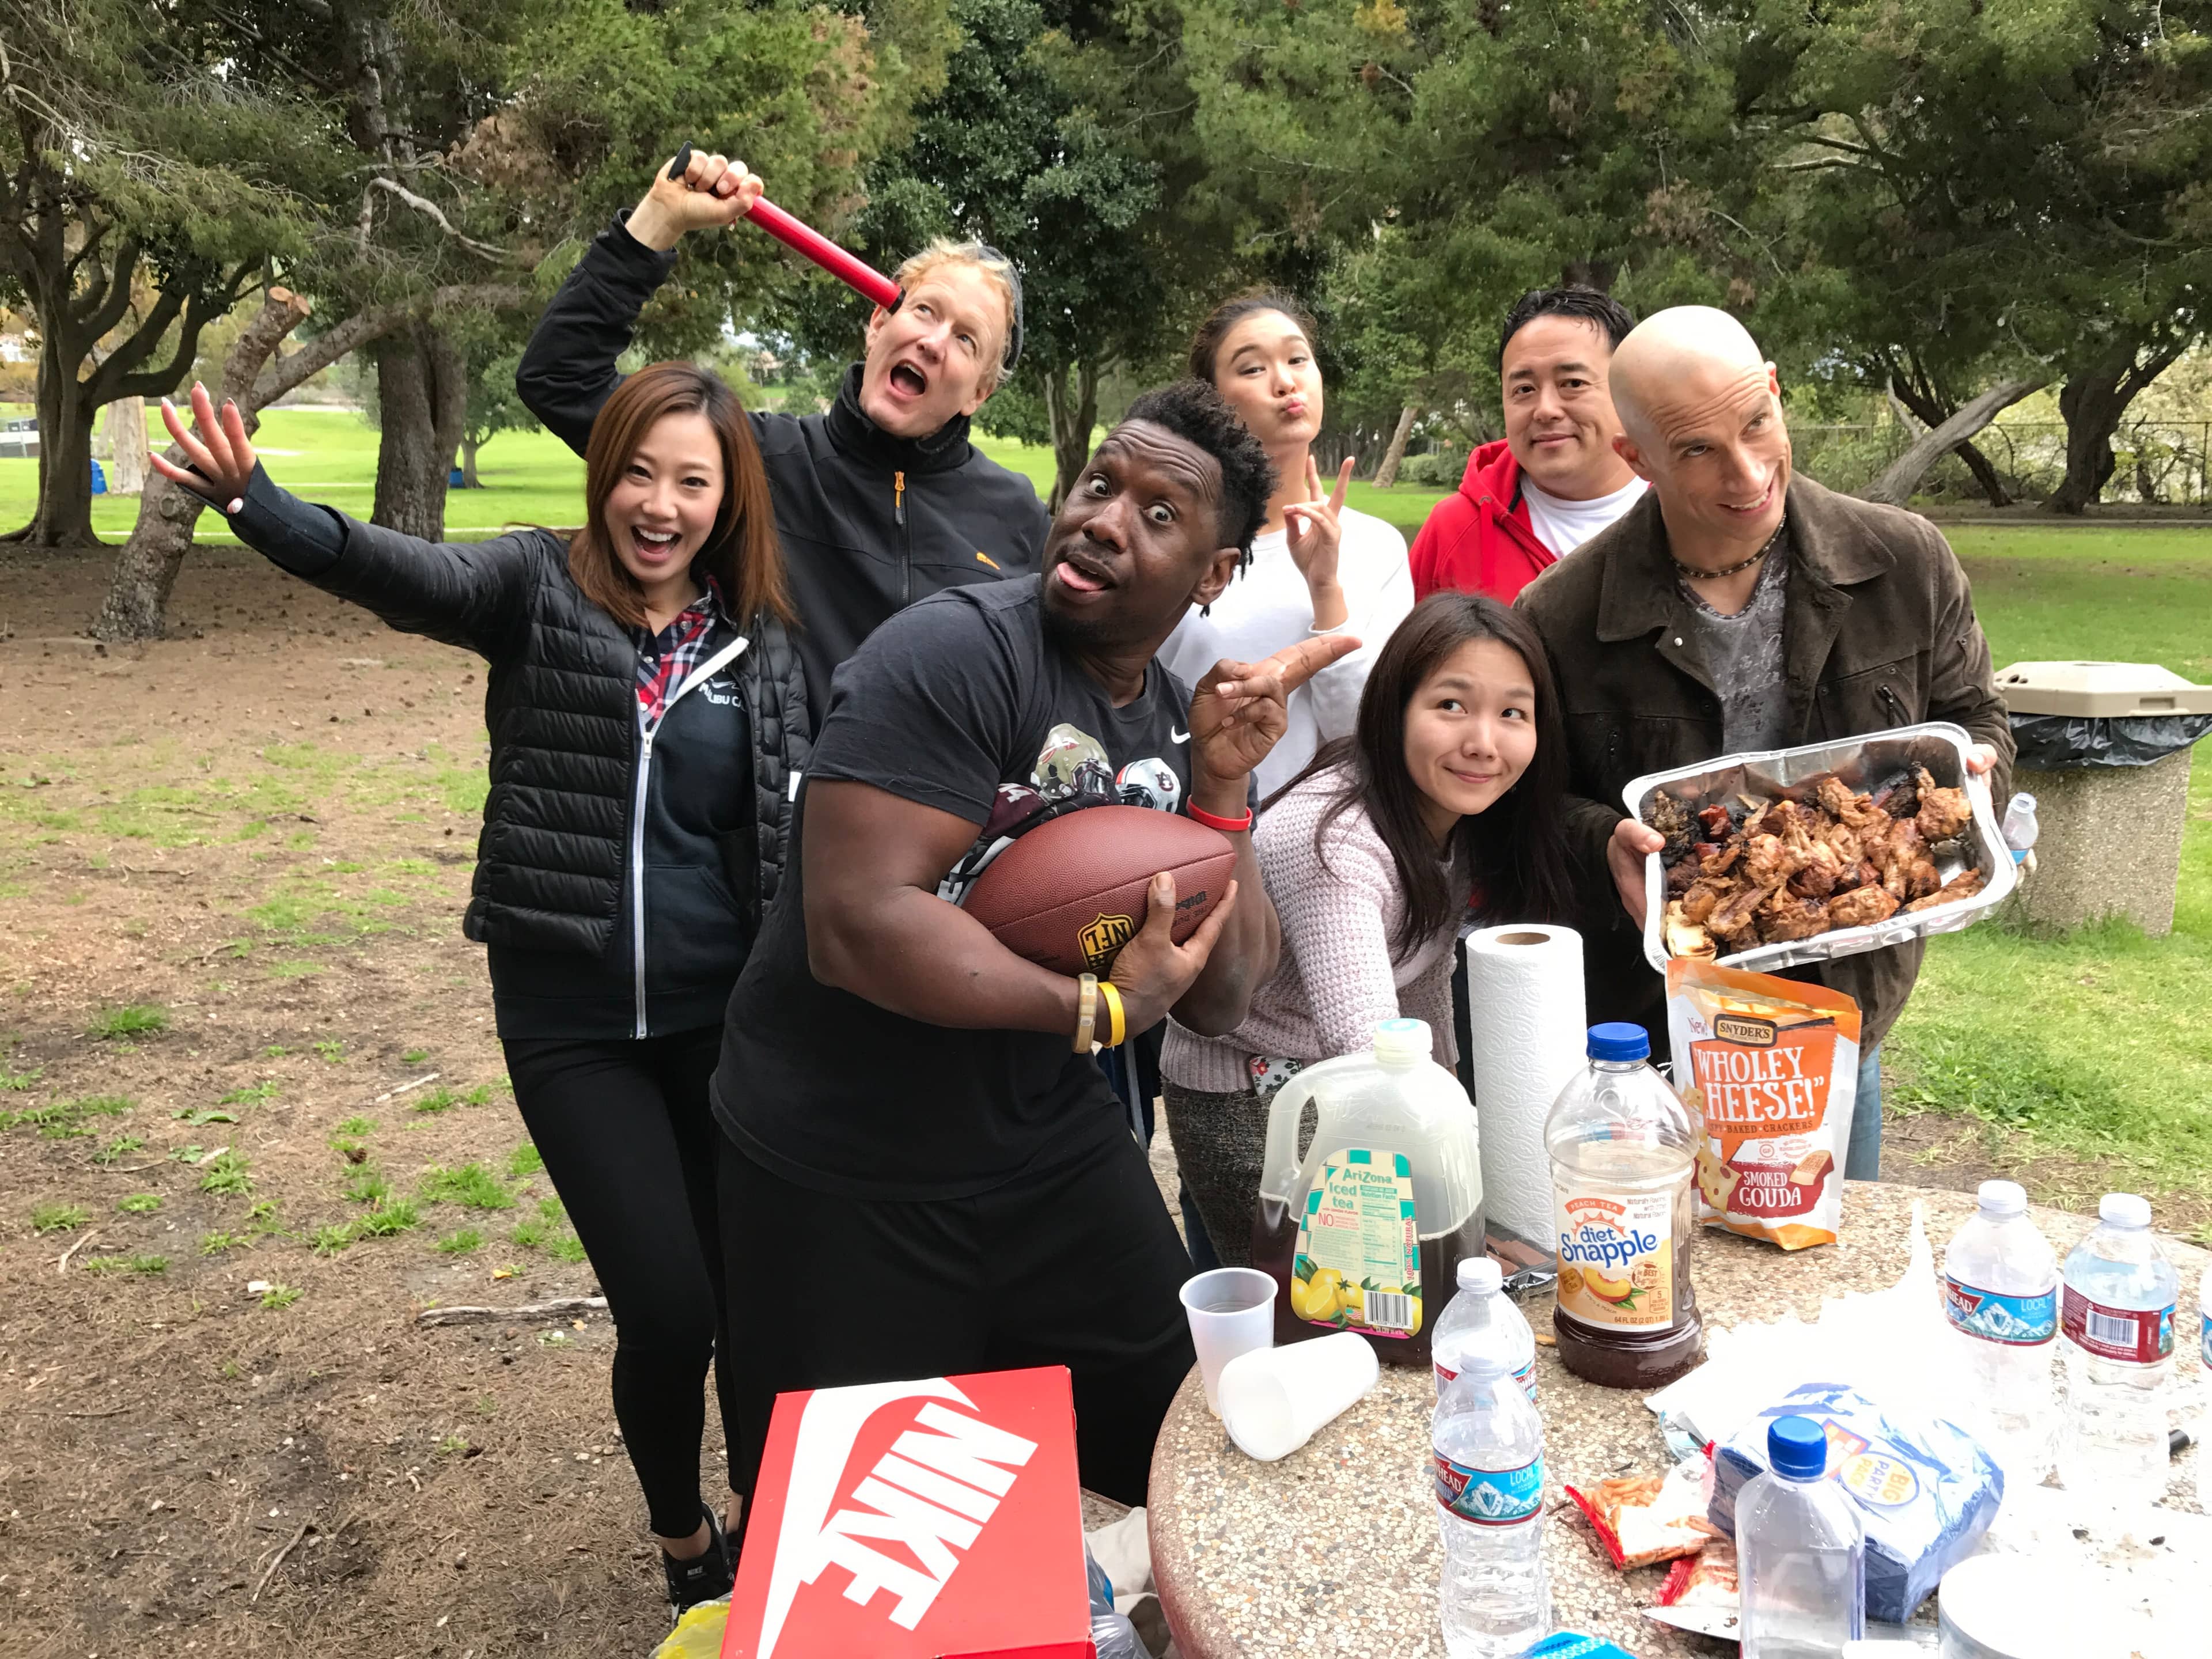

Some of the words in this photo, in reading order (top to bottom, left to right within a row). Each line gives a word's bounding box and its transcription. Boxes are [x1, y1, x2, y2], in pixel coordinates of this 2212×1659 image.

[1084, 922, 1129, 952] NFL
[1719, 1022, 1770, 1039] SNYDER'S
[1705, 1075, 1825, 1122] HEESE!”
[1710, 1123, 1723, 1132] SPY
[1726, 1124, 1757, 1134] BAKED
[1763, 1120, 1813, 1132] CRACKERS
[1342, 1168, 1392, 1184] AriZona
[1743, 1171, 1788, 1187] SMOKED
[1329, 1181, 1357, 1196] Iced
[1332, 1196, 1354, 1210] tea
[1570, 1199, 1596, 1210] PEACH
[1600, 1202, 1619, 1211] TEA
[1739, 1187, 1802, 1208] GOUDA
[1318, 1212, 1334, 1226] NO
[1405, 1216, 1413, 1255] NATURAL
[1580, 1226, 1616, 1243] diet
[1561, 1229, 1658, 1268] Snapple
[1643, 1269, 1657, 1277] BEST
[1657, 1290, 1662, 1298] 5
[1435, 1463, 1461, 1493] HEAD
[1865, 1460, 1890, 1499] PARTY
[1882, 1472, 1910, 1502] BIG
[801, 1401, 1039, 1631] NIKE
